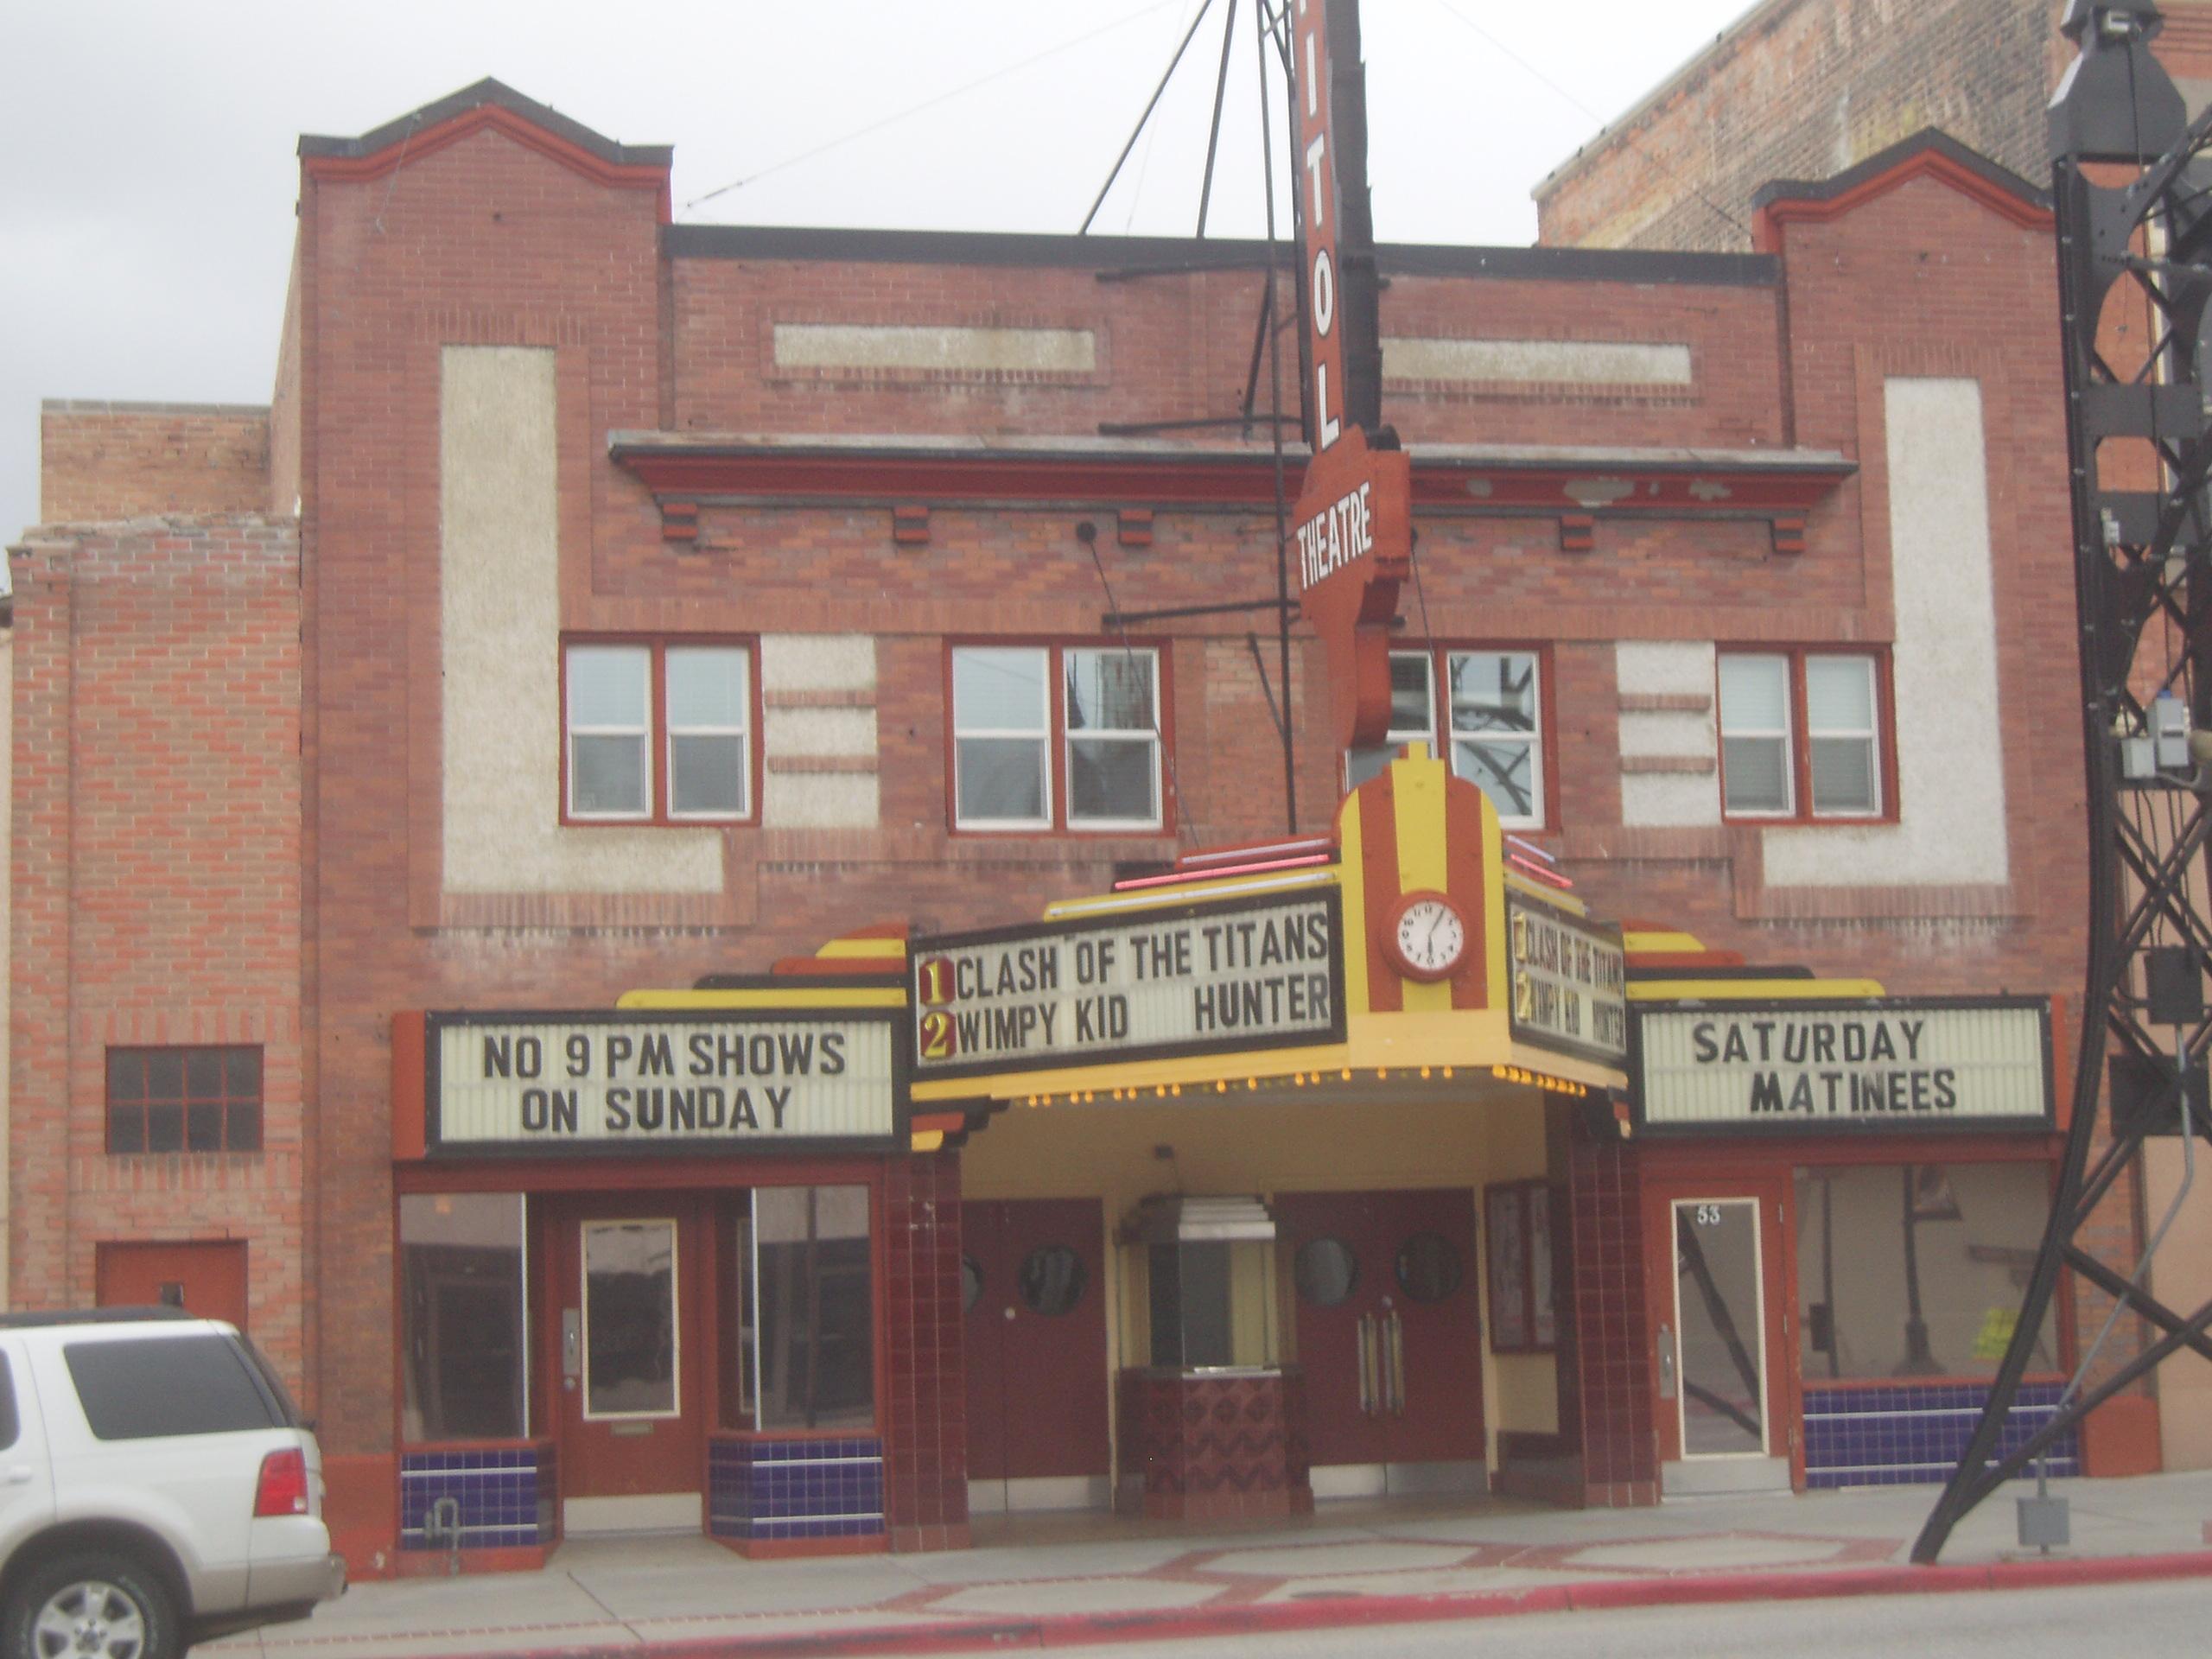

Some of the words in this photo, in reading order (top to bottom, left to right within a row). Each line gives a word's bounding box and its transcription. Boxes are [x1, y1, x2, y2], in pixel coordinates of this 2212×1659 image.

[1299, 0, 1340, 450] ITOL
[1297, 481, 1372, 591] THEATRE
[926, 961, 944, 1005] 1
[957, 945, 1058, 1001] CLASH
[1077, 939, 1115, 984] OF
[1130, 930, 1192, 980] THE
[1202, 912, 1328, 972] TITANS
[925, 1012, 947, 1058] 2
[957, 1002, 1057, 1053] WIMPY
[1076, 995, 1128, 1042] KID
[1194, 972, 1329, 1031] HUNTER
[1693, 1020, 1924, 1064] SATURDAY
[484, 1033, 542, 1078] NO
[566, 1033, 591, 1078] 9
[607, 1033, 675, 1078] PM
[689, 1033, 846, 1077] SHOWS
[522, 1088, 578, 1133] ON
[605, 1085, 792, 1131] SUNDAY
[1750, 1069, 1957, 1112] MATINEES
